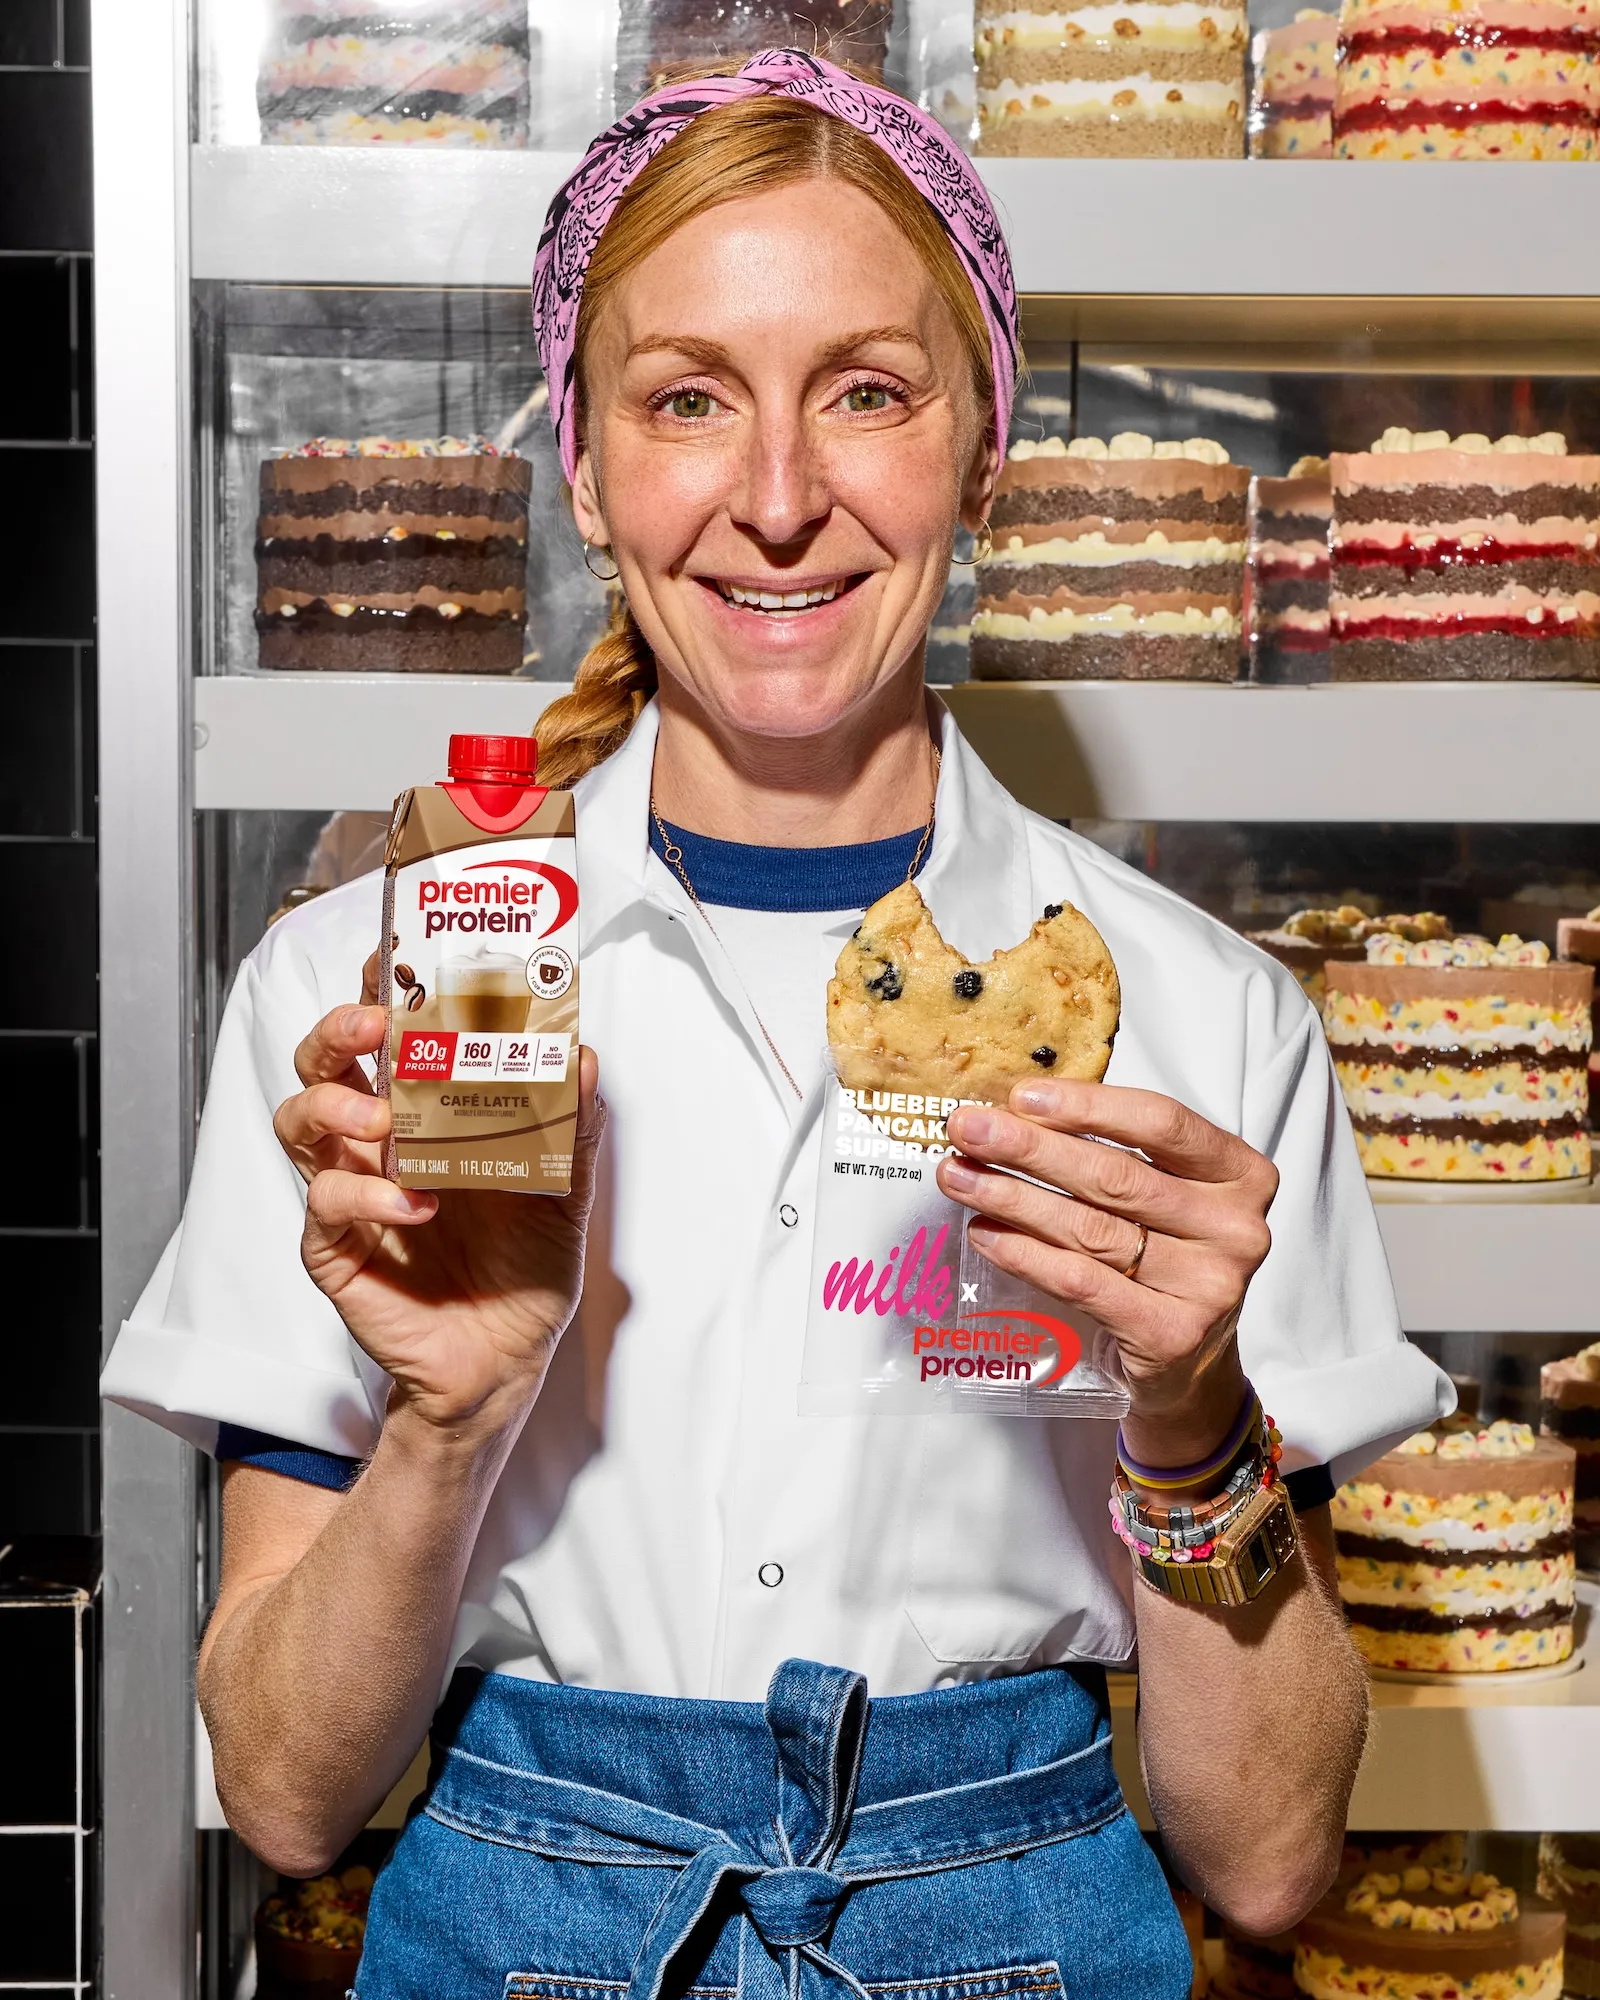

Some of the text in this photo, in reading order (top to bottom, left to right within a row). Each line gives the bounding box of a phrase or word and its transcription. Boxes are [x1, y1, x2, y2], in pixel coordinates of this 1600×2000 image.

[419, 875, 544, 910] premier
[531, 951, 569, 971] CAFFEINE EQUALS
[546, 969, 551, 979] 1
[532, 981, 541, 990] CUP
[550, 981, 567, 995] COFFEE
[409, 1039, 447, 1061] 30g
[464, 1043, 491, 1059] 160
[508, 1043, 529, 1059] 24
[405, 1063, 447, 1071] PROTEIN
[440, 1093, 529, 1108] CAFÉ LATTE
[839, 1088, 993, 1117] BLUEBER
[837, 1112, 950, 1141] PANCAK
[834, 1134, 922, 1162] SUPER
[398, 1159, 449, 1174] PROTEIN SHAKE
[459, 1160, 468, 1175] 11
[470, 1161, 480, 1175] FL
[482, 1161, 494, 1176] OZ
[496, 1160, 529, 1178] (325mL)
[834, 1162, 922, 1181] NET WT. 77g (2.72 oz)
[823, 1223, 953, 1321] milk
[913, 1325, 1046, 1355] premier
